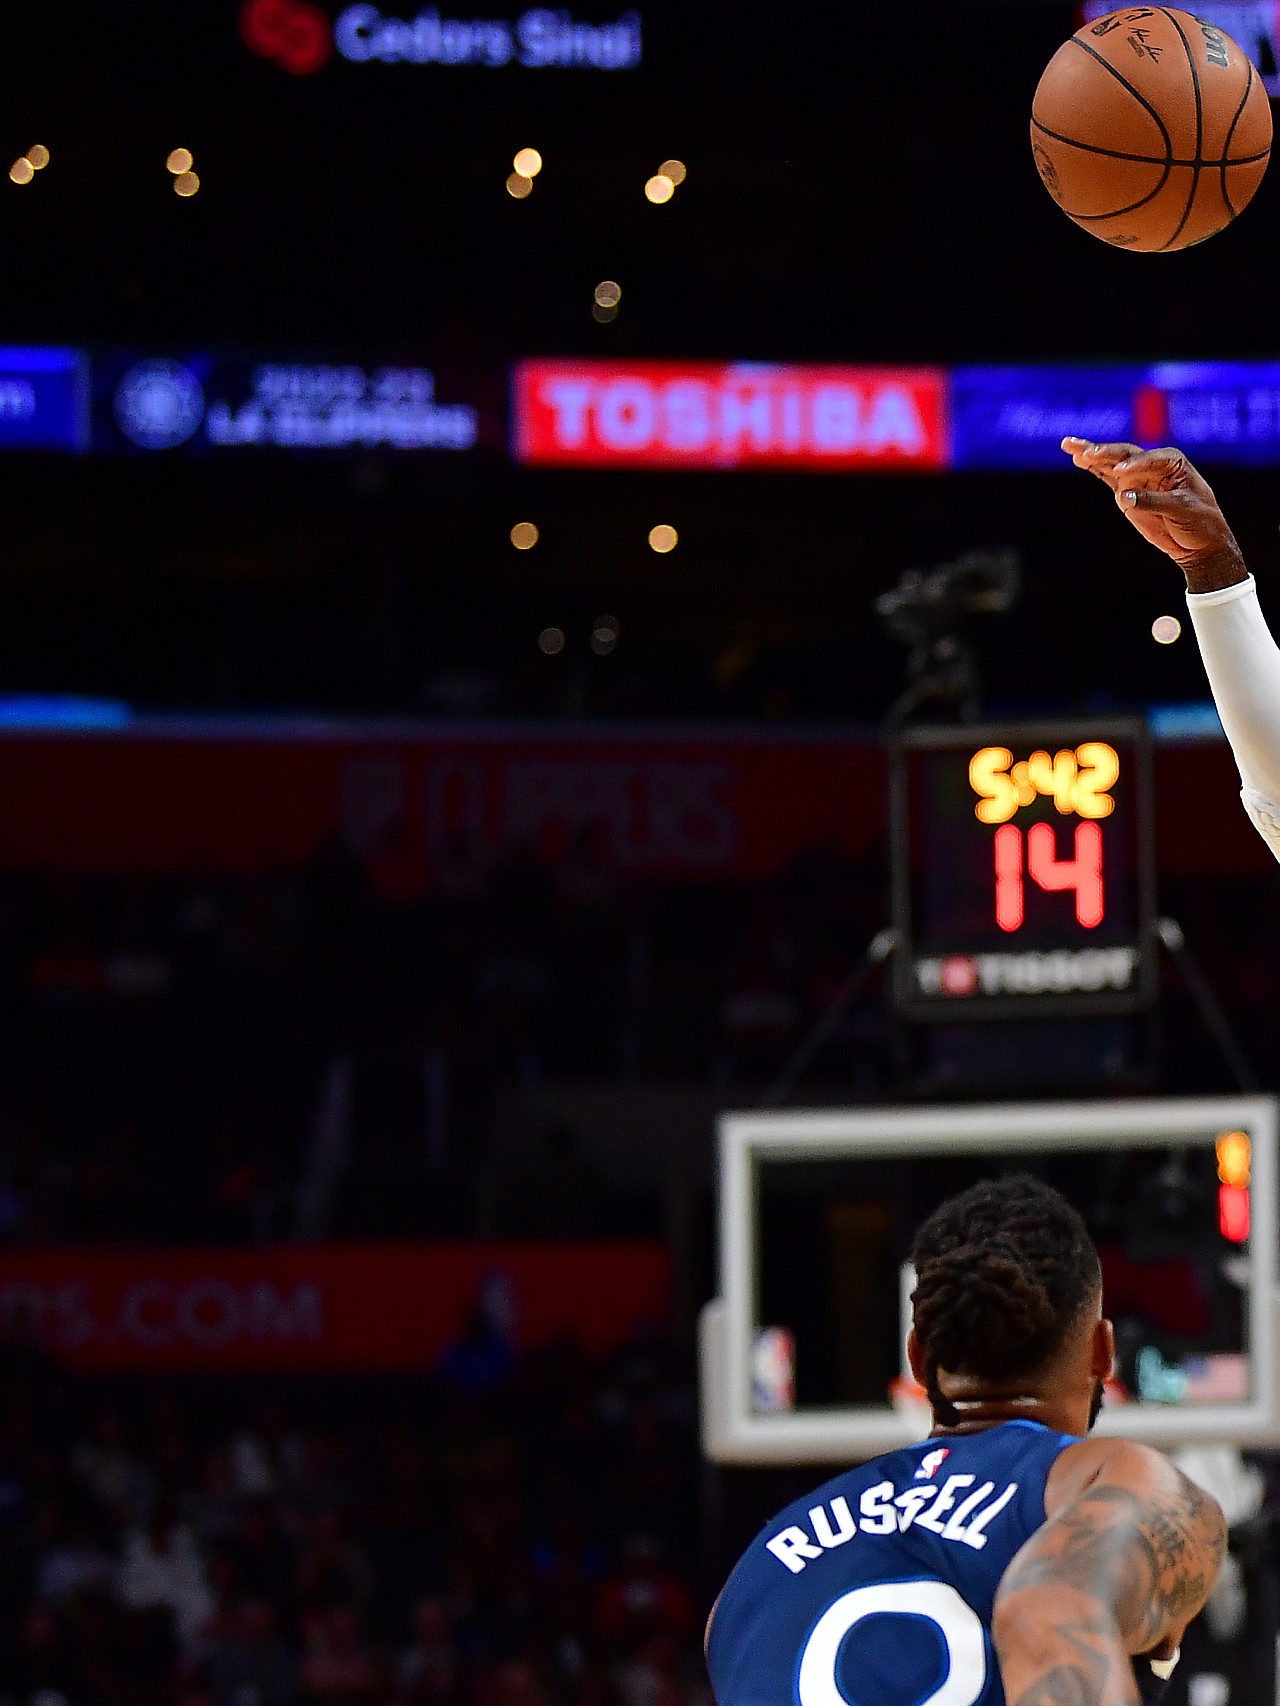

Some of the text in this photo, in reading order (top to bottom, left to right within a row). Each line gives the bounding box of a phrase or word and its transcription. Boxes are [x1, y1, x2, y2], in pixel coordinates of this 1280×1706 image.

[334, 3, 641, 70] Cedars Sinai
[541, 376, 924, 456] TOSHIBA
[969, 742, 1120, 824] 5:42
[995, 820, 1104, 932] 14
[977, 948, 1133, 995] TISSOT
[765, 1473, 1019, 1575] RUSSELL
[798, 1579, 987, 1706] 0
